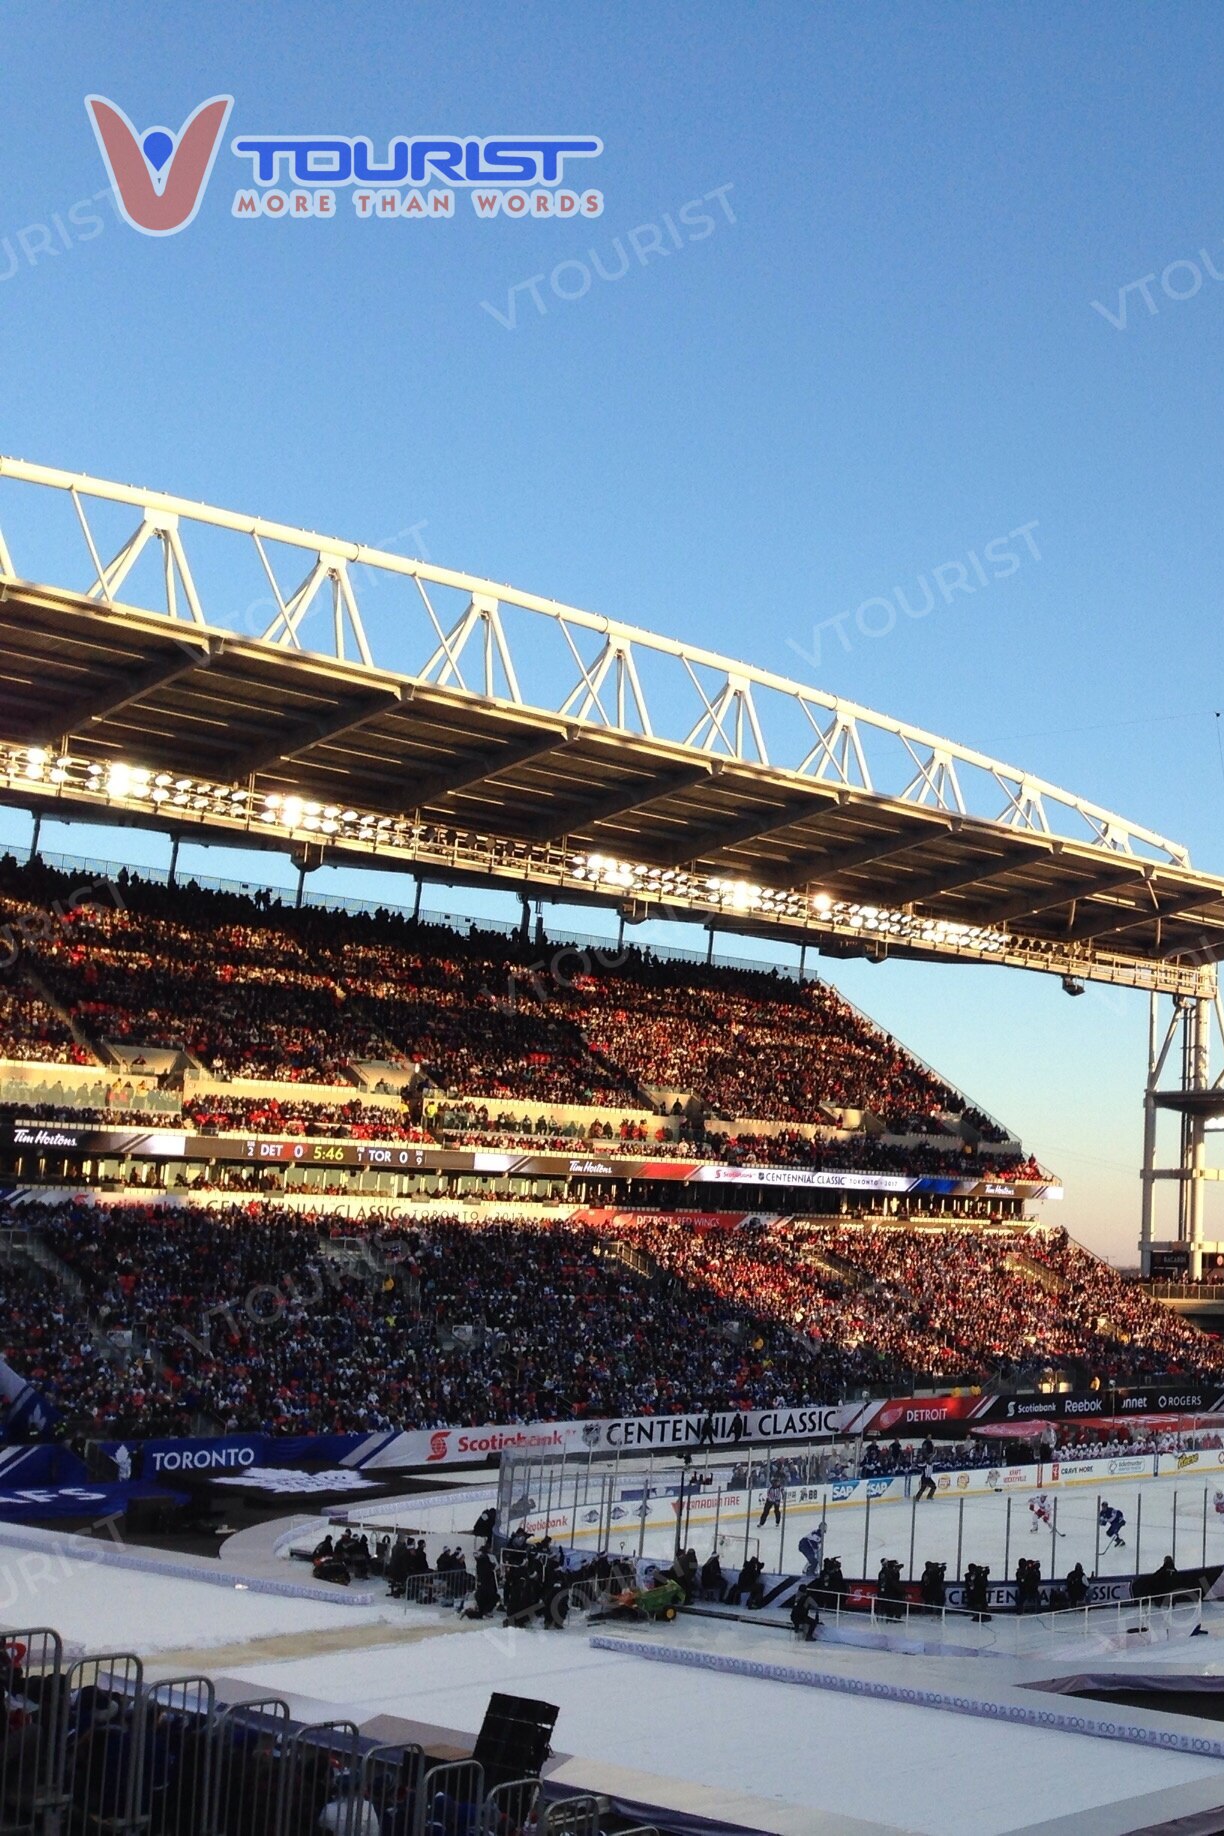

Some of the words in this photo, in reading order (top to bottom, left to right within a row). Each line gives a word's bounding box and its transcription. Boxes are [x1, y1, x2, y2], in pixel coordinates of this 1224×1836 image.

[14, 1129, 34, 1144] Tim
[260, 1144, 283, 1156] DET
[294, 1145, 303, 1158] 0
[313, 1147, 344, 1160] 5:46
[368, 1150, 391, 1163] TOR
[400, 1151, 408, 1164] 0
[569, 1160, 584, 1172] Tim
[766, 1173, 815, 1184] CENTENNIAL
[817, 1175, 845, 1186] CLASSIC
[694, 1217, 720, 1226] WINGS
[1065, 1399, 1102, 1413] Reebok
[1168, 1395, 1202, 1406] ROGERS
[1017, 1402, 1056, 1414] Scotiabank
[906, 1408, 948, 1422] DETROIT
[458, 1430, 562, 1452] Scotiabank
[758, 1410, 838, 1436] CLASSIC
[152, 1448, 255, 1471] TORONTO
[1061, 1467, 1077, 1475] CRAVE
[1078, 1465, 1093, 1473] MORE
[832, 1485, 854, 1498] SAP
[868, 1483, 889, 1494] SAP
[724, 1496, 740, 1506] TIRE
[727, 1658, 739, 1667] 100
[750, 1663, 763, 1672] 100
[774, 1667, 787, 1677] 100
[798, 1671, 812, 1681] 100
[823, 1675, 837, 1686] 100
[848, 1679, 862, 1690] 100
[873, 1684, 888, 1695] 100
[900, 1689, 915, 1699] 100
[926, 1693, 942, 1704] 100
[954, 1698, 970, 1709] 100
[982, 1702, 997, 1714] 100
[1010, 1707, 1026, 1718] 100
[1038, 1712, 1055, 1724] 100
[1068, 1717, 1084, 1729] 100
[1098, 1722, 1115, 1734] 100
[1128, 1727, 1146, 1740] 100
[1159, 1733, 1178, 1745] 100
[1192, 1738, 1210, 1751] 100
